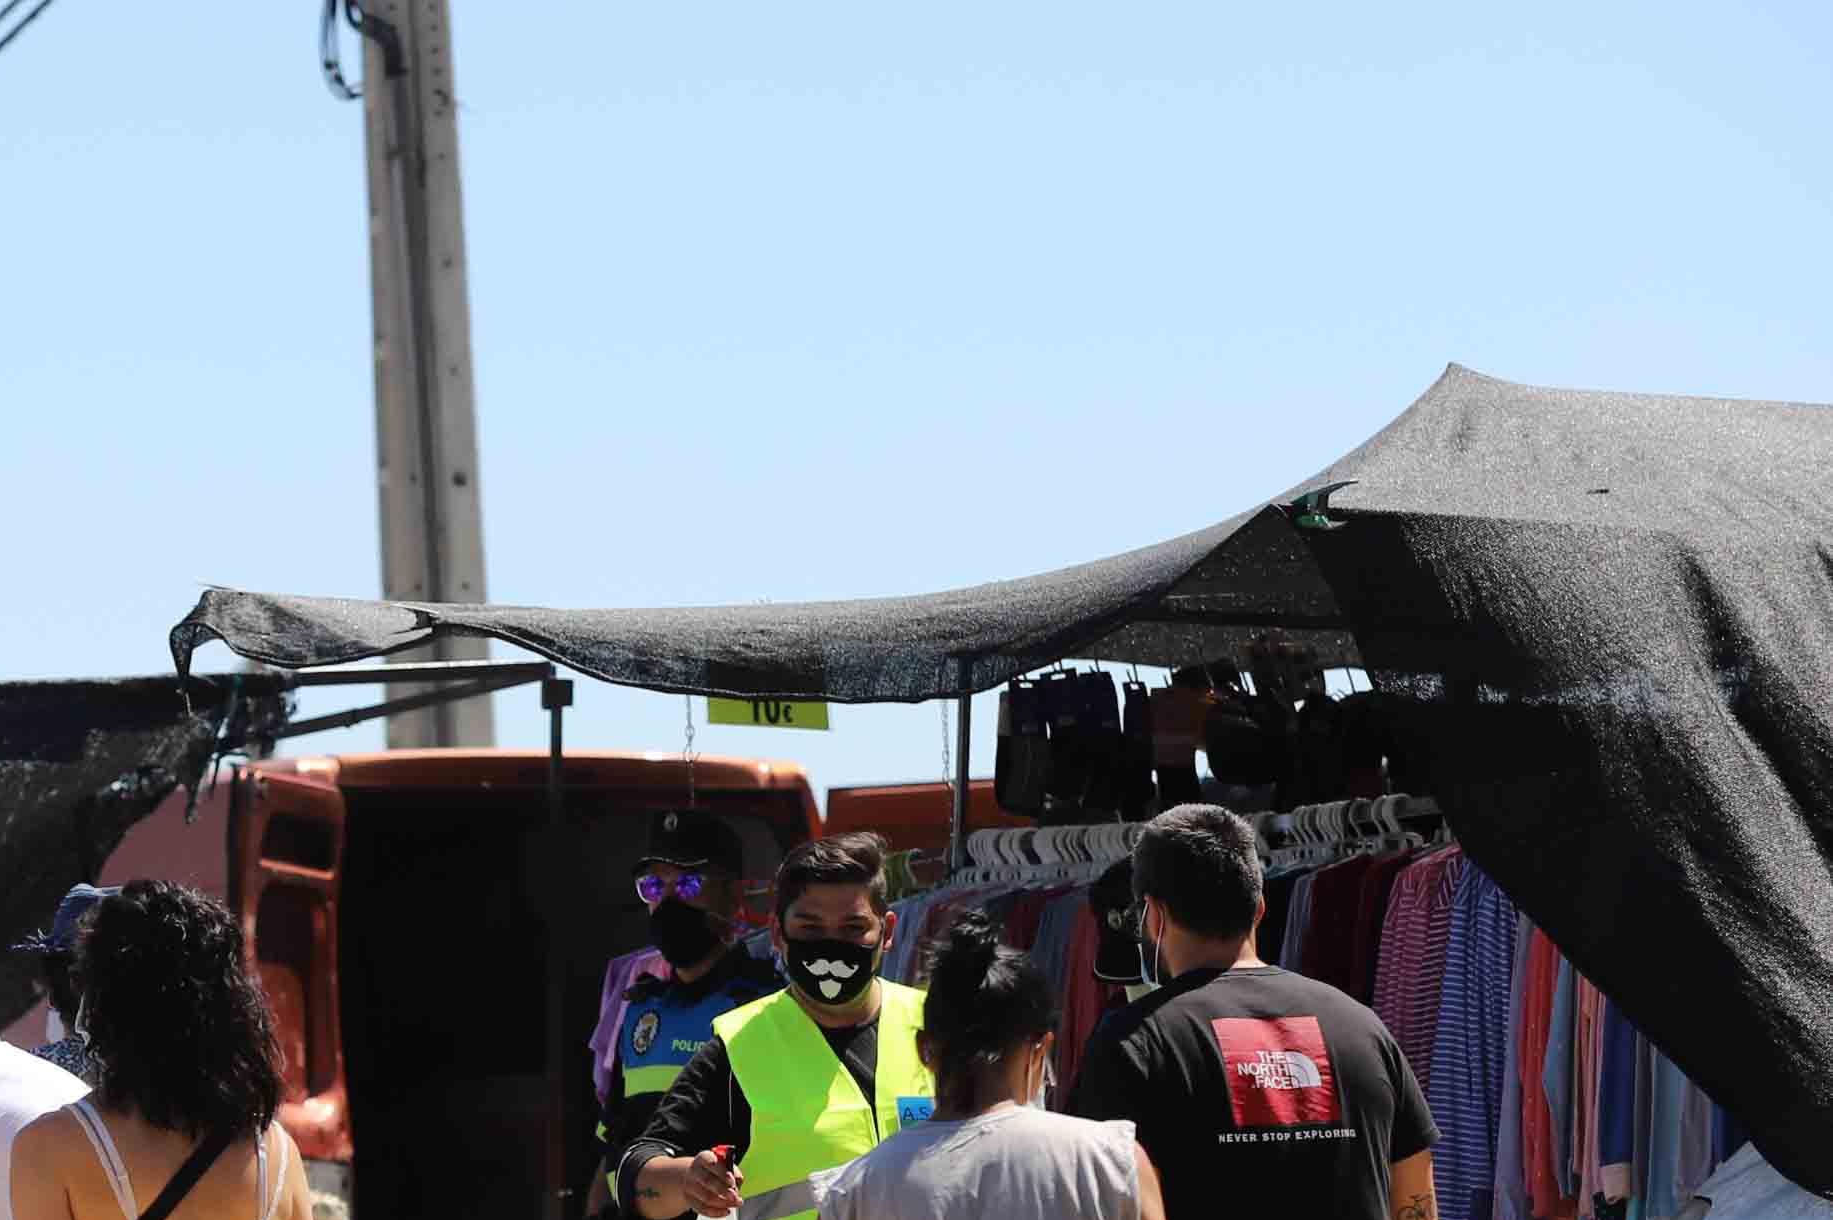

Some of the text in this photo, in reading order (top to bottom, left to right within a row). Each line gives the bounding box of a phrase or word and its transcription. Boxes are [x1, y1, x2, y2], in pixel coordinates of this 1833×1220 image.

[1256, 1050, 1286, 1064] THE
[1237, 1062, 1289, 1077] NORTH
[1255, 1076, 1293, 1089] FACE
[1219, 1128, 1356, 1143] NEVER STOP EXPLORING
